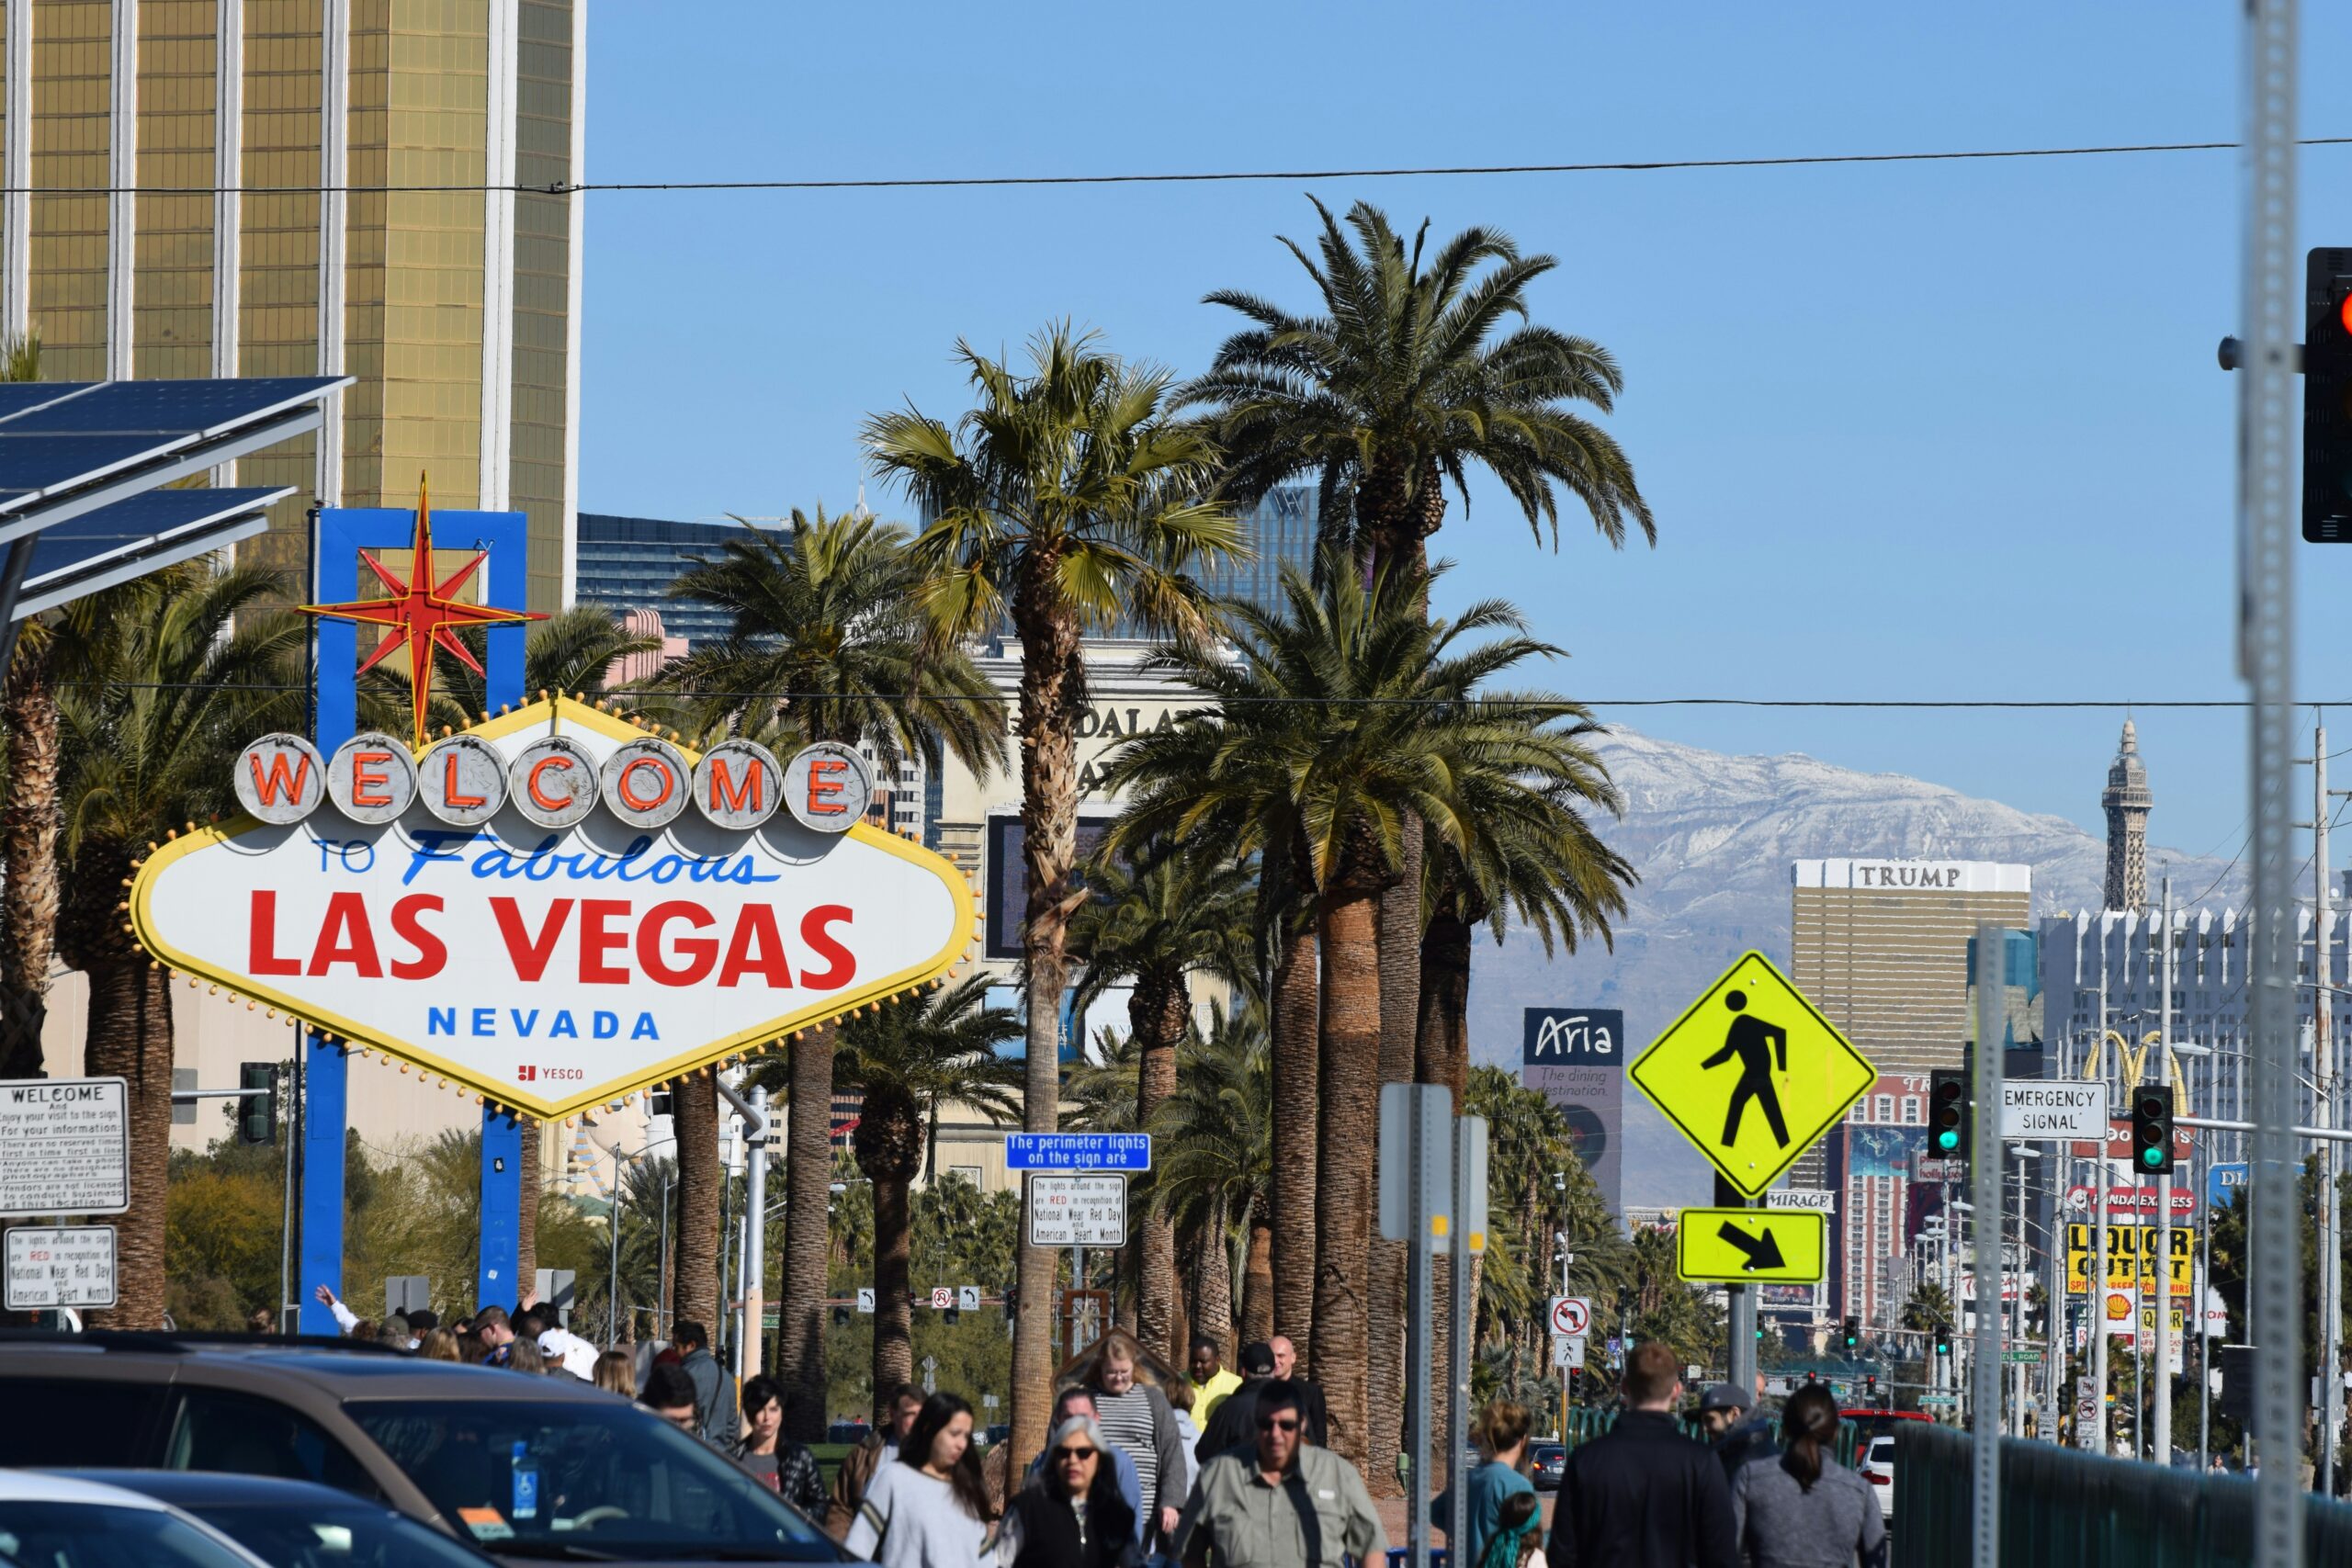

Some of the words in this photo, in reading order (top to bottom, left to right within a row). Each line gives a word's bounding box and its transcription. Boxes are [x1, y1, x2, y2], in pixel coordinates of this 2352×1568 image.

[249, 751, 849, 814] WELCOME
[311, 838, 376, 874] TO
[401, 829, 782, 886] Fabulous
[1859, 866, 1961, 887] TRUMP
[249, 889, 447, 981] LAS
[488, 897, 857, 991] VEGAS
[428, 1006, 661, 1040] NEVADA
[1535, 1016, 1612, 1056] Aria
[542, 1067, 583, 1080] YESCO
[1540, 1067, 1566, 1082] The
[1567, 1067, 1607, 1085] dining
[11, 1086, 105, 1103] WELCOME
[2005, 1089, 2096, 1107] EMERGENCY
[25, 1112, 45, 1122] your
[48, 1111, 67, 1121] visit
[71, 1111, 79, 1120] to
[82, 1110, 96, 1119] the
[2022, 1113, 2078, 1130] SIGNAL
[1, 1126, 18, 1136] For
[22, 1126, 48, 1138] your
[1010, 1135, 1034, 1149] The
[1039, 1135, 1104, 1152] perimeter
[1109, 1135, 1147, 1153] lights
[1028, 1153, 1044, 1164] on
[1048, 1152, 1069, 1164] the
[1074, 1152, 1102, 1168] sign
[1106, 1153, 1127, 1164] are
[5, 1184, 42, 1192] Vendors
[1035, 1181, 1046, 1190] The
[1050, 1181, 1066, 1192] lights
[1070, 1181, 1091, 1190] around
[1095, 1181, 1104, 1190] the
[1109, 1181, 1122, 1192] sign
[19, 1191, 67, 1200] conduct
[72, 1190, 123, 1199] business
[1049, 1195, 1068, 1205] RED
[1073, 1196, 1079, 1204] in
[1080, 1196, 1113, 1206] recognition
[1115, 1196, 1121, 1204] of
[1769, 1194, 1830, 1209] MIRAGE
[2092, 1194, 2136, 1205] NDA
[2140, 1195, 2194, 1208] EXESS
[22, 1201, 47, 1209] this
[51, 1199, 105, 1208] location
[1035, 1208, 1063, 1221] National
[1069, 1208, 1084, 1221] Wear
[1090, 1208, 1102, 1221] Red
[1108, 1208, 1121, 1224] Day
[1035, 1229, 1067, 1240] American
[1074, 1228, 1092, 1240] Heart
[1100, 1228, 1121, 1240] Month
[29, 1251, 50, 1261] RED
[9, 1266, 43, 1280] National
[50, 1264, 68, 1279] Wear
[74, 1264, 89, 1279] Red
[95, 1263, 110, 1281] Day
[2077, 1257, 2185, 1279] OTLT
[12, 1290, 48, 1303] American
[87, 1287, 110, 1301] Month
